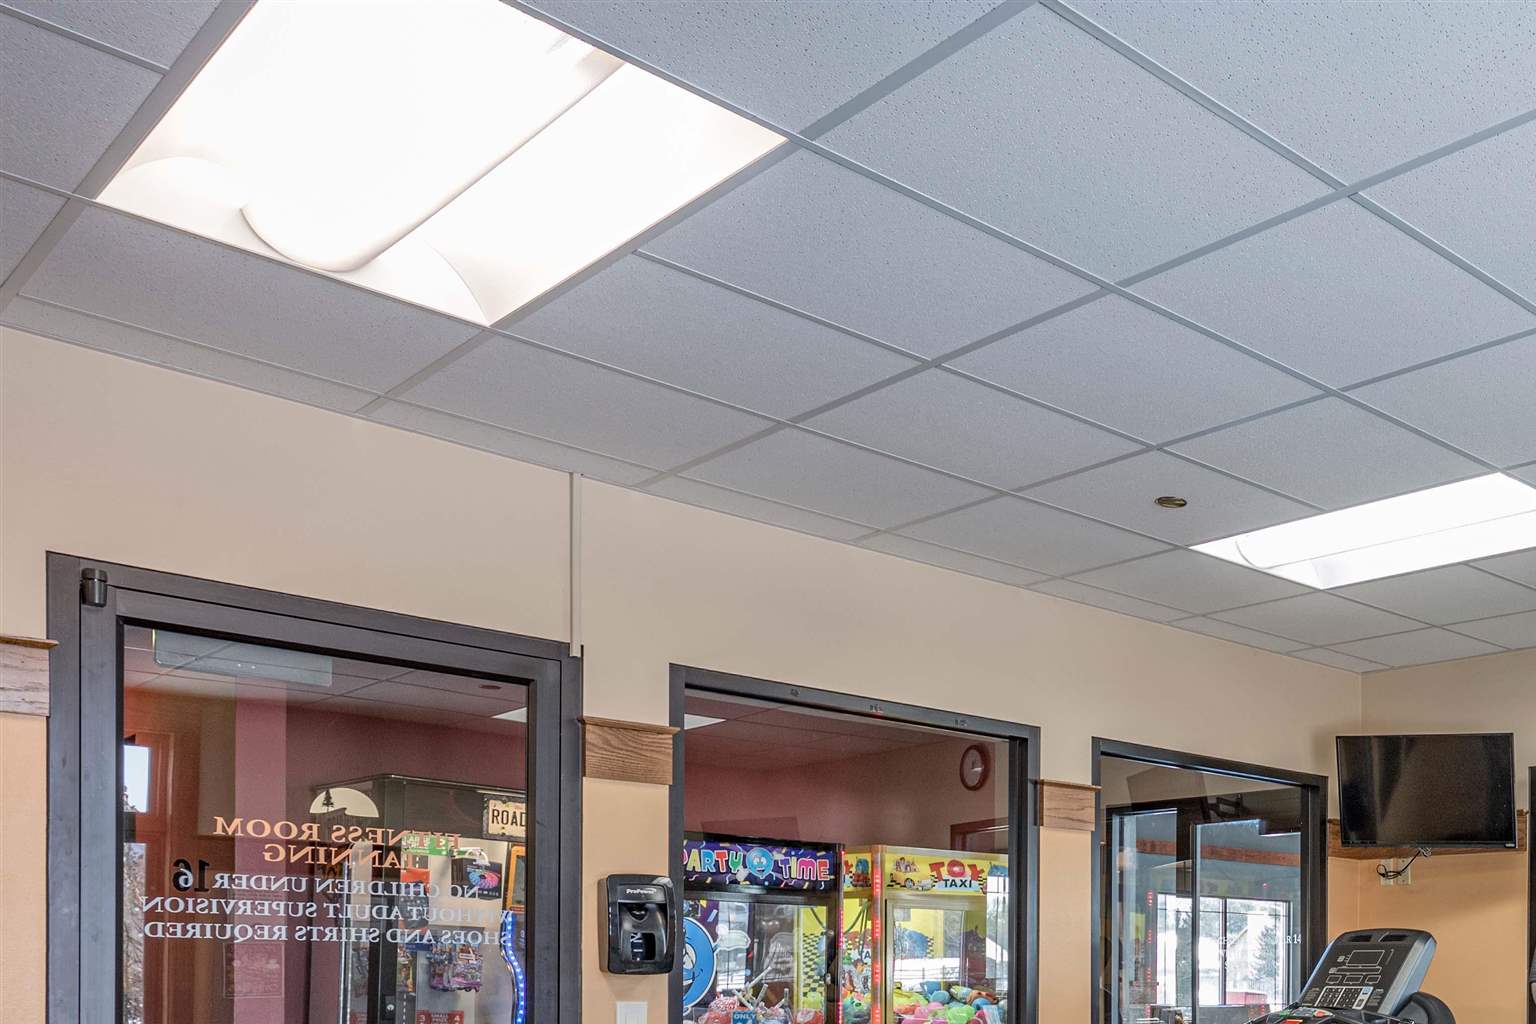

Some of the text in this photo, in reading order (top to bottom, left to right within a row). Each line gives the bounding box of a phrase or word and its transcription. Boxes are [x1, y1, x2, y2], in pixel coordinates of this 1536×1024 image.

[778, 857, 830, 881] TIME
[929, 859, 985, 881] TOY
[943, 878, 972, 889] TAXI
